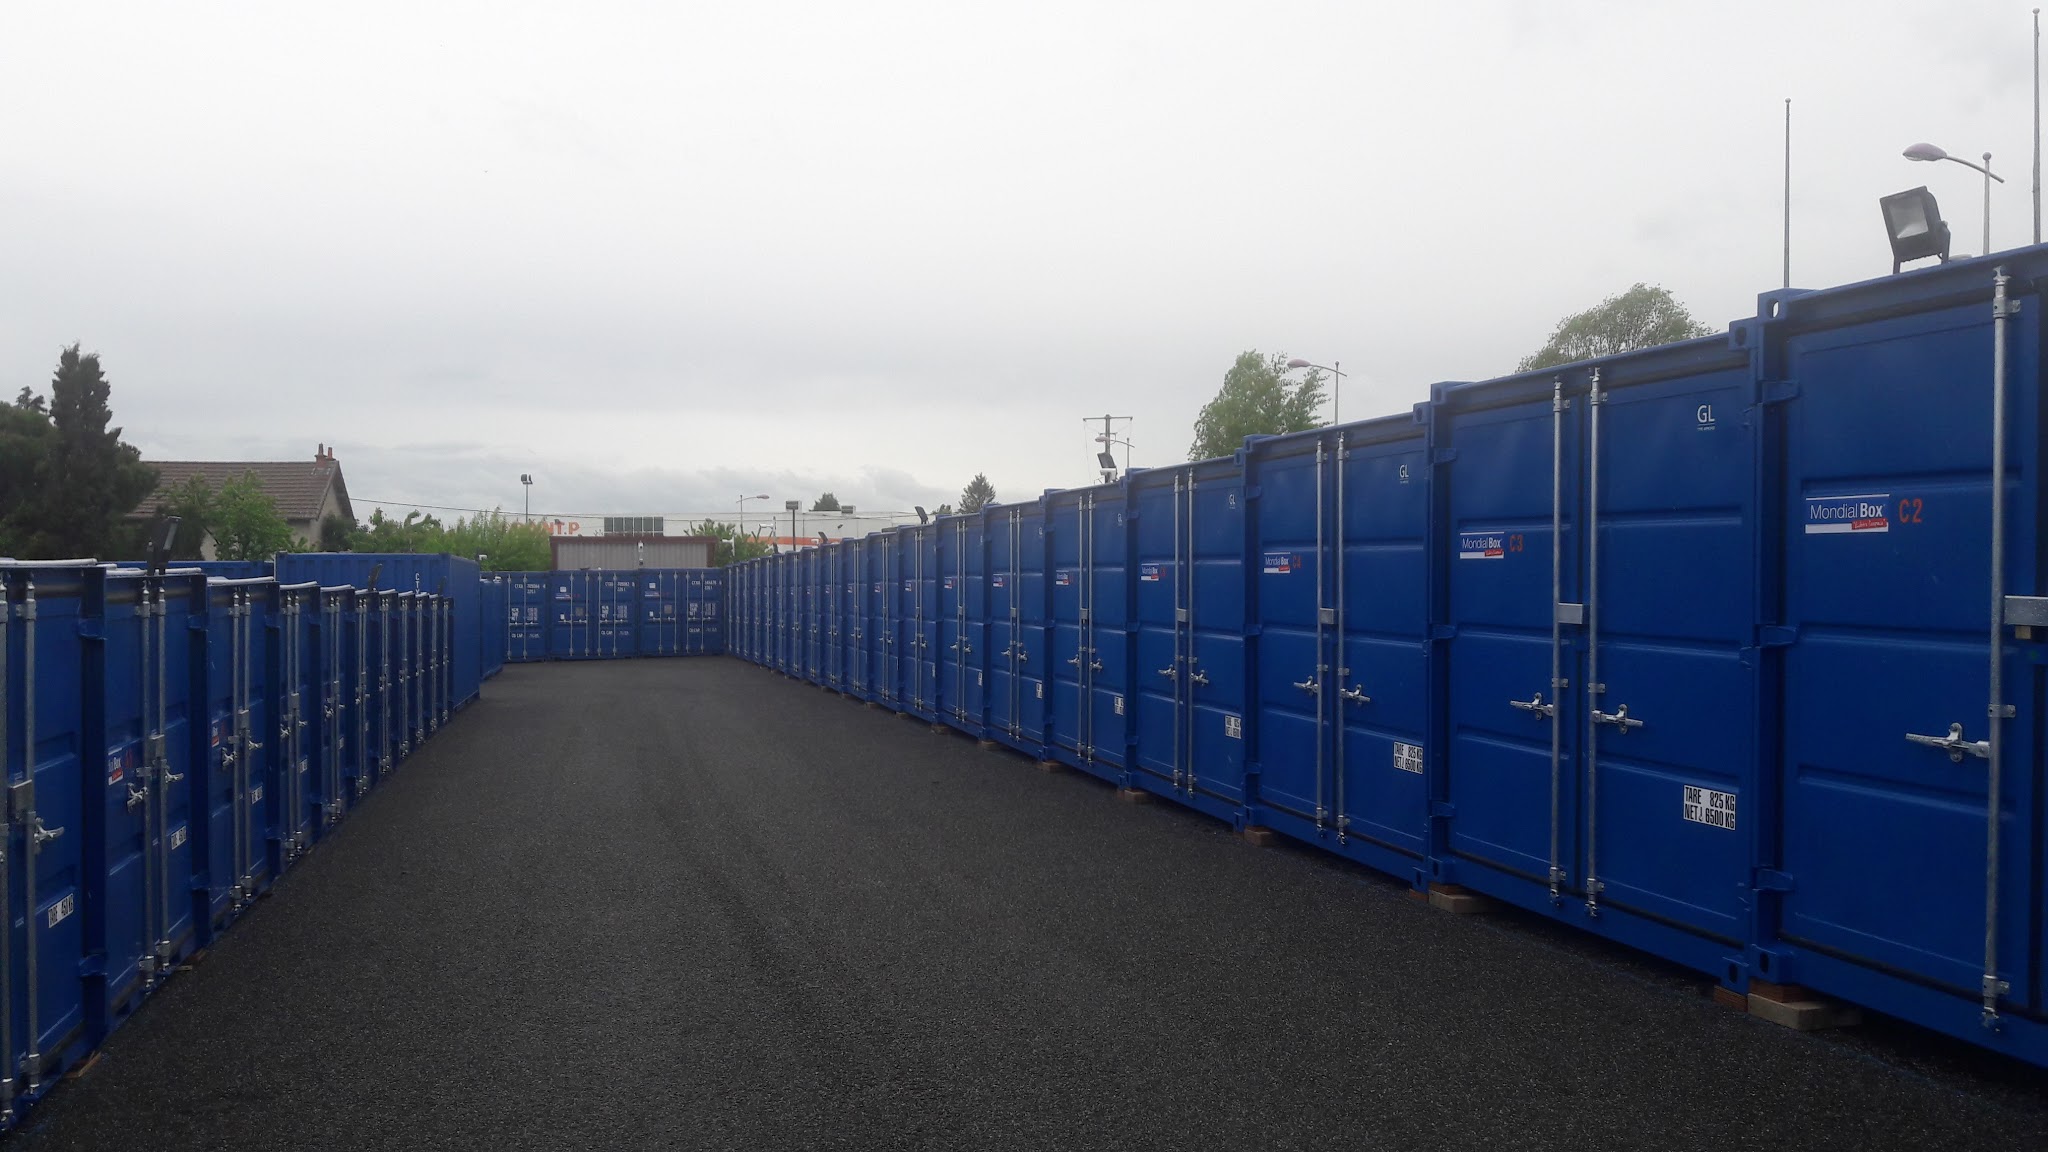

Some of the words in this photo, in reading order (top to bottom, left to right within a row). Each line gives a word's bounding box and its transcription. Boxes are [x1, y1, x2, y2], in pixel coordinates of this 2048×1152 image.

[1697, 404, 1715, 423] GL
[1399, 464, 1409, 478] GL
[1899, 498, 1923, 523] C2
[1685, 787, 1701, 804] TARE
[1709, 791, 1724, 808] 825
[1725, 795, 1735, 812] KG
[1705, 808, 1724, 826] 6500
[1725, 813, 1735, 828] KG
